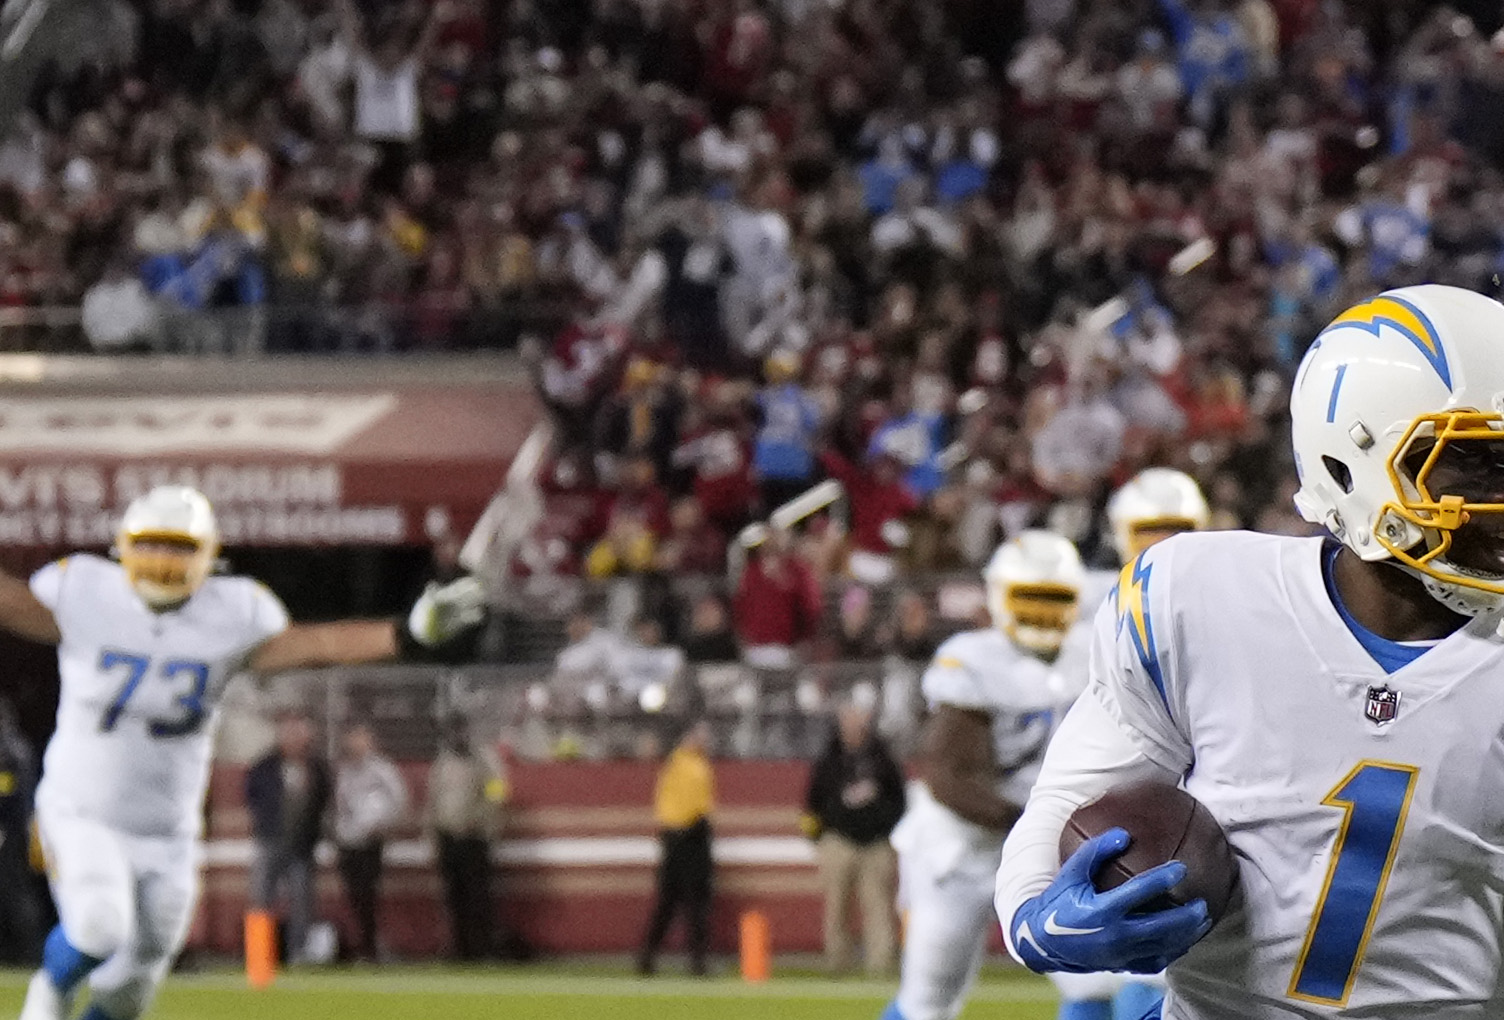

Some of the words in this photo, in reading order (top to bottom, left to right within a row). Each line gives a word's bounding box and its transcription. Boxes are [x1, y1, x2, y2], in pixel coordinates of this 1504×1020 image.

[1326, 363, 1349, 423] 1
[98, 648, 210, 740] 73
[1367, 700, 1395, 719] NFL
[1287, 758, 1420, 1008] 1
